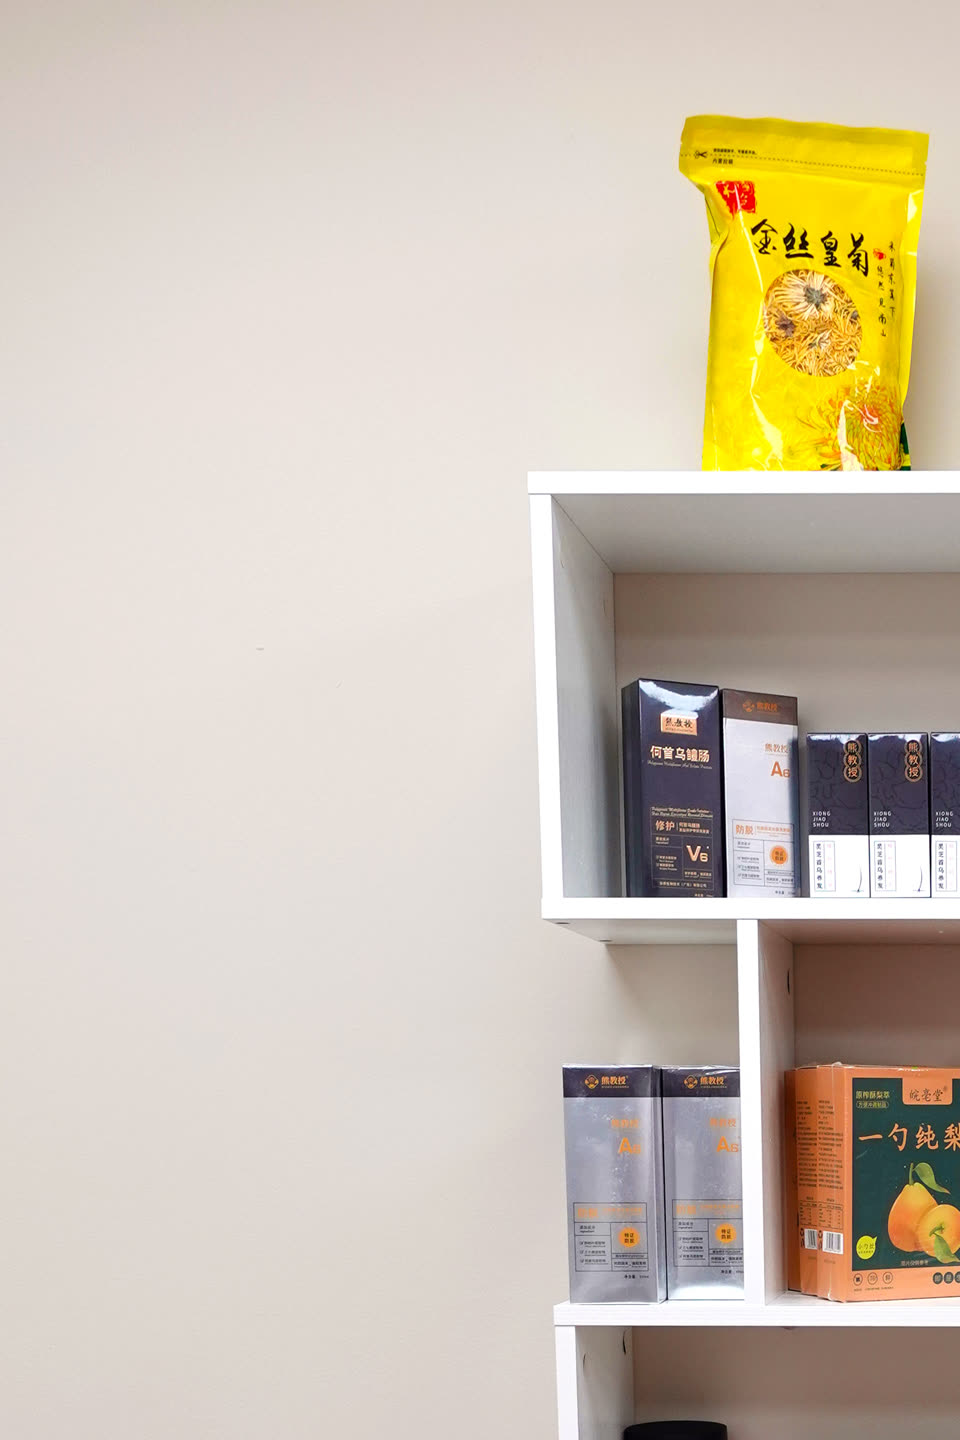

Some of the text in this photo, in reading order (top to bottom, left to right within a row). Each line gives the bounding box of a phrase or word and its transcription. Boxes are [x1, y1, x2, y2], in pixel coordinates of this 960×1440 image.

[751, 218, 869, 277] 金丝皇菊
[847, 742, 857, 777] 熊教授
[908, 742, 918, 777] 熊教授
[771, 761, 790, 778] A6
[655, 820, 675, 832] 修护
[686, 845, 708, 862] V6
[601, 1076, 626, 1085] 熊教授
[700, 1076, 724, 1085] 熊教授
[618, 1137, 641, 1154] A6
[716, 1135, 738, 1152] A6
